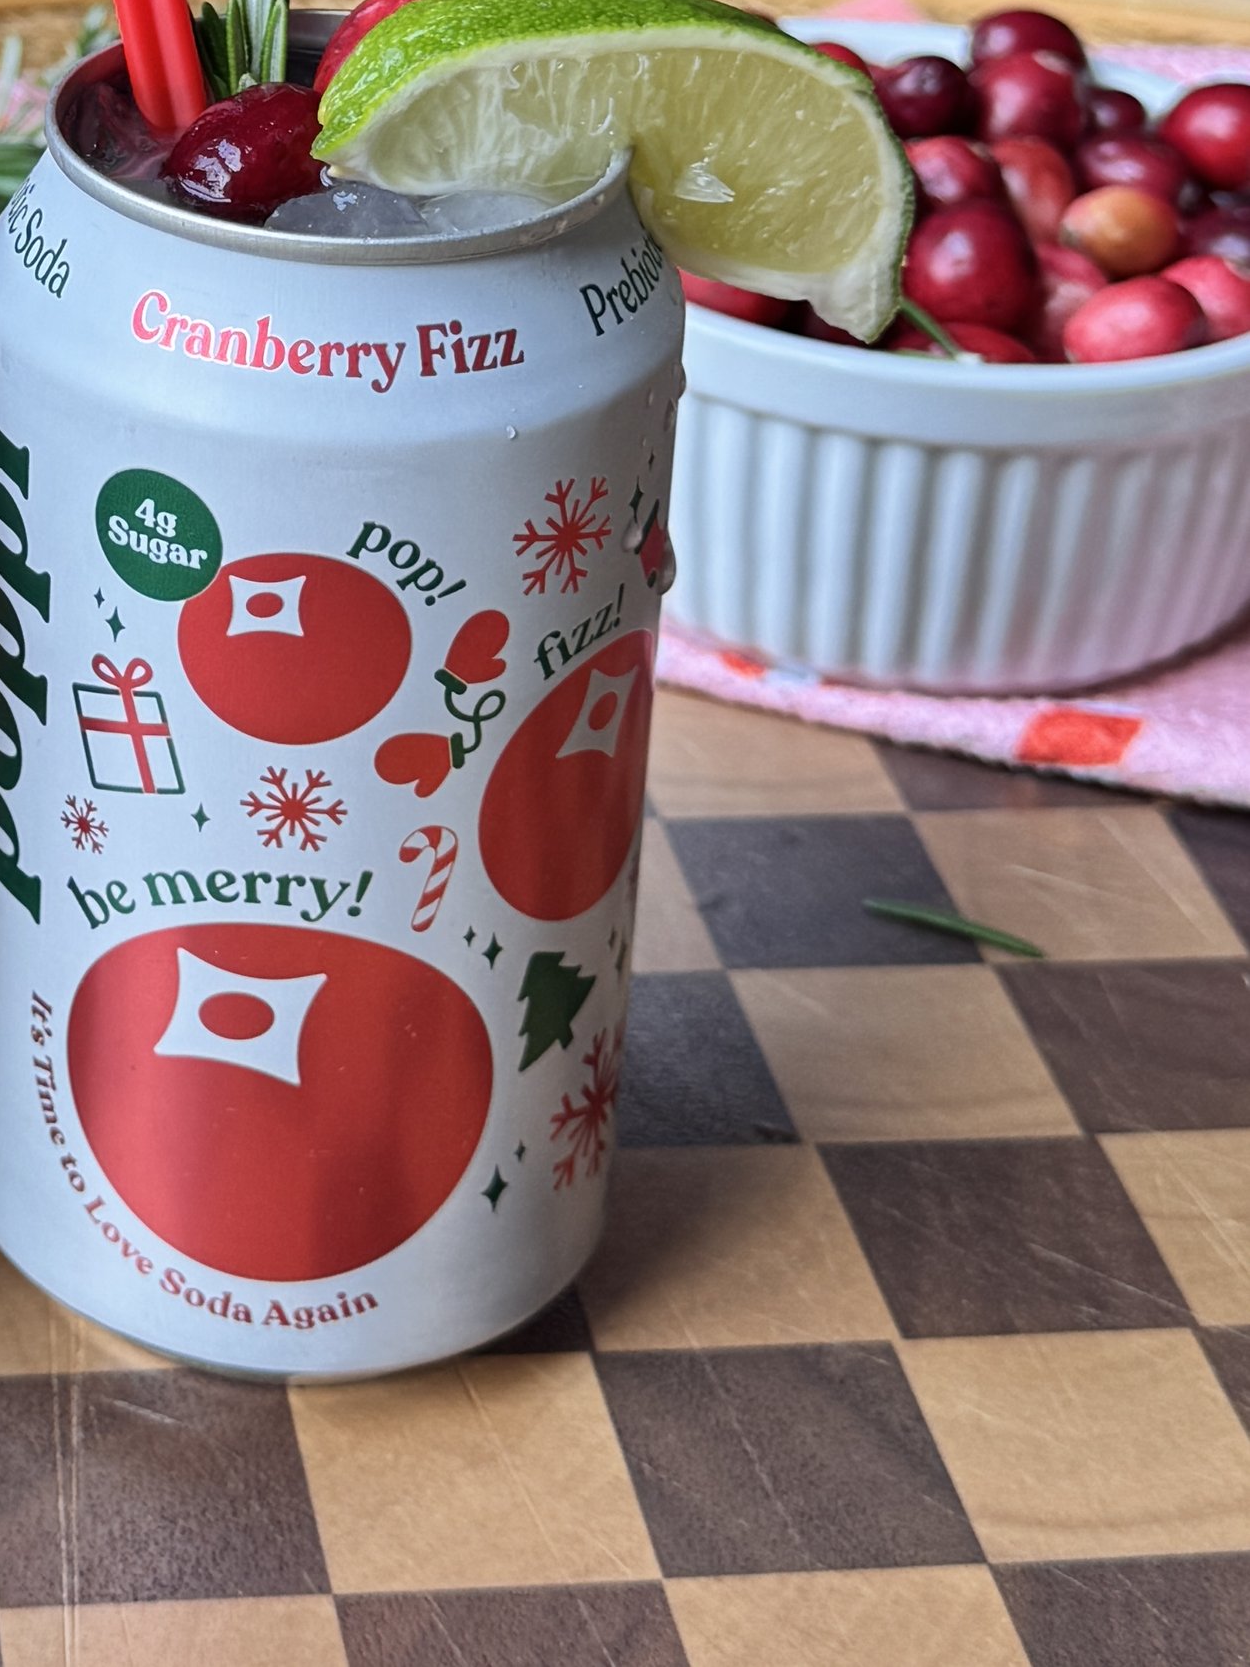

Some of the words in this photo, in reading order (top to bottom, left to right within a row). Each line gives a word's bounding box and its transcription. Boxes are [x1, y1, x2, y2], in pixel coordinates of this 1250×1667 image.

[14, 207, 71, 299] Soda
[131, 289, 406, 394] Cranberry
[415, 319, 526, 378] Fizz
[107, 514, 209, 570] Sugar
[134, 497, 178, 538] 4g
[345, 520, 468, 607] pop!
[532, 582, 626, 682] fizz!
[66, 875, 137, 930] be
[142, 869, 374, 923] merry!
[32, 1054, 66, 1146] Time
[59, 1151, 86, 1194] to
[82, 1194, 155, 1275] Love
[158, 1267, 254, 1325] Soda
[261, 1290, 380, 1331] Again
